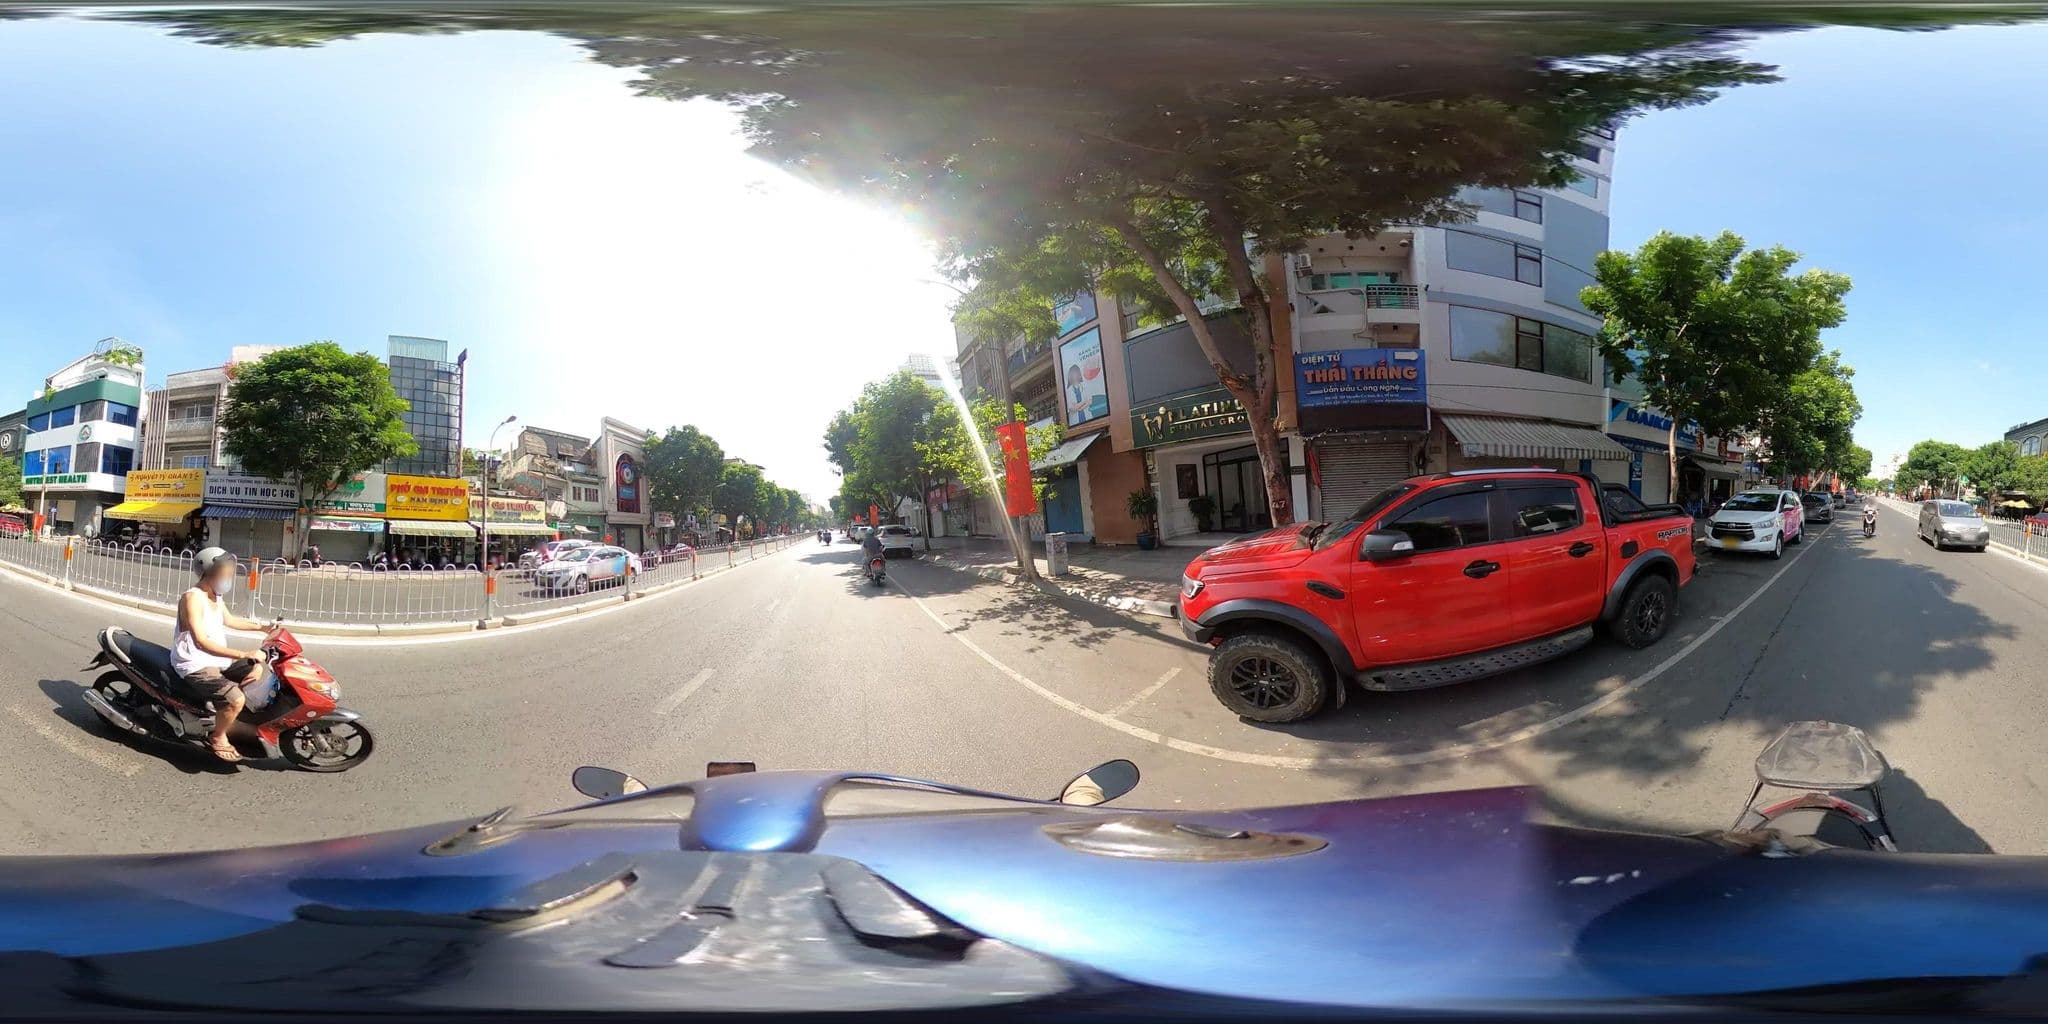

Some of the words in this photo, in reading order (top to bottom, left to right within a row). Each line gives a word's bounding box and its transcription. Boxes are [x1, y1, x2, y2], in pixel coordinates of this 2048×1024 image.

[1304, 363, 1347, 384] THÁI
[1352, 358, 1417, 382] THẮNG
[1170, 419, 1215, 433] DENTAL
[59, 475, 87, 484] HEALTH
[244, 487, 258, 497] TIN
[280, 489, 295, 499] 146
